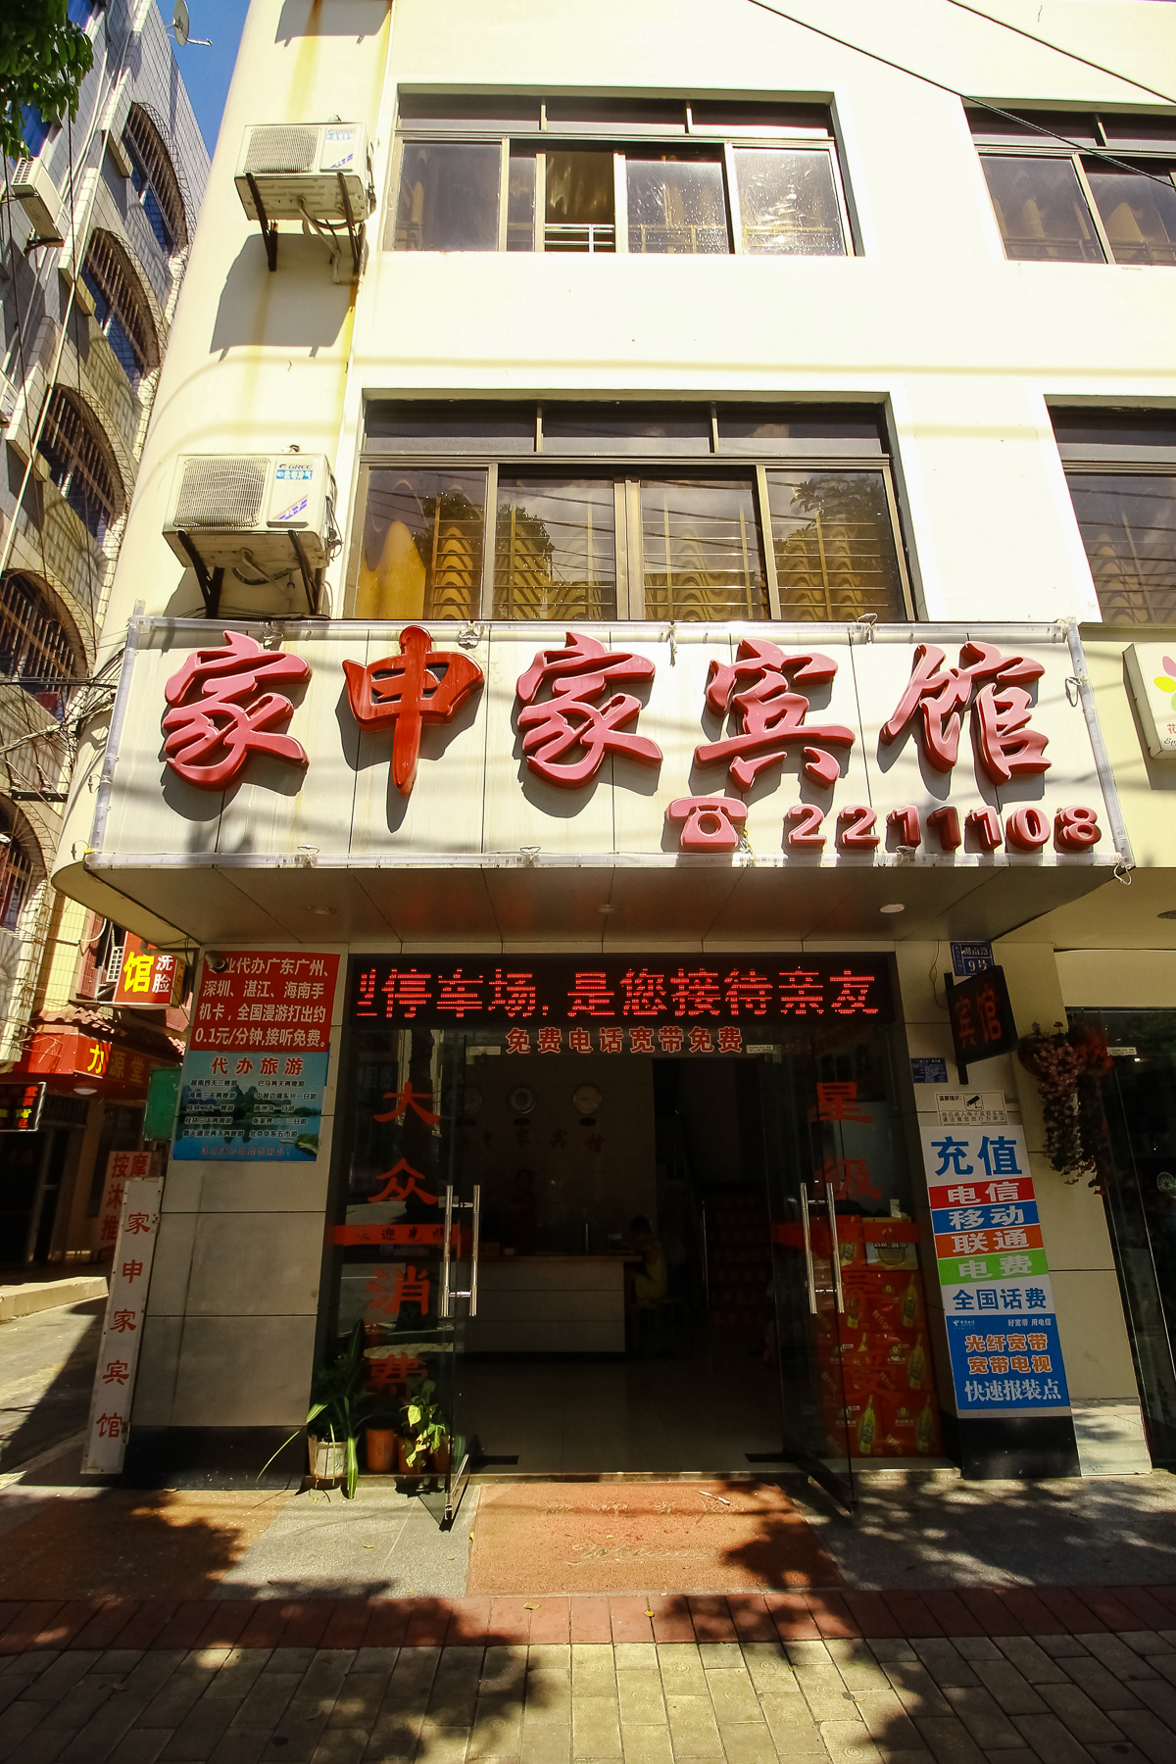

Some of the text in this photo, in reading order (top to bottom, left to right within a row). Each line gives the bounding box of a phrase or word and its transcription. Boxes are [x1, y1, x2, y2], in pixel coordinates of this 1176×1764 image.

[783, 804, 1102, 852] 2211108
[123, 951, 155, 993] 馆
[152, 955, 173, 993] 洗脸
[209, 957, 329, 977] 业代办广东广州、
[505, 1026, 744, 1054] 免费电话宽带免费
[211, 1056, 304, 1076] 代办旅游
[111, 1152, 149, 1178] 按摩
[931, 1135, 1022, 1177] 充值
[947, 1181, 1020, 1204] 电信
[949, 1205, 1025, 1230] 移动
[951, 1228, 1030, 1254] 联通
[958, 1254, 1033, 1279] 电费
[952, 1287, 1046, 1311] 全国话费
[96, 1212, 151, 1438] 家申家宾馆
[964, 1333, 1049, 1353] 光纤宽带
[967, 1355, 1053, 1375] 宽带电视
[964, 1378, 1062, 1402] 快速报装点
